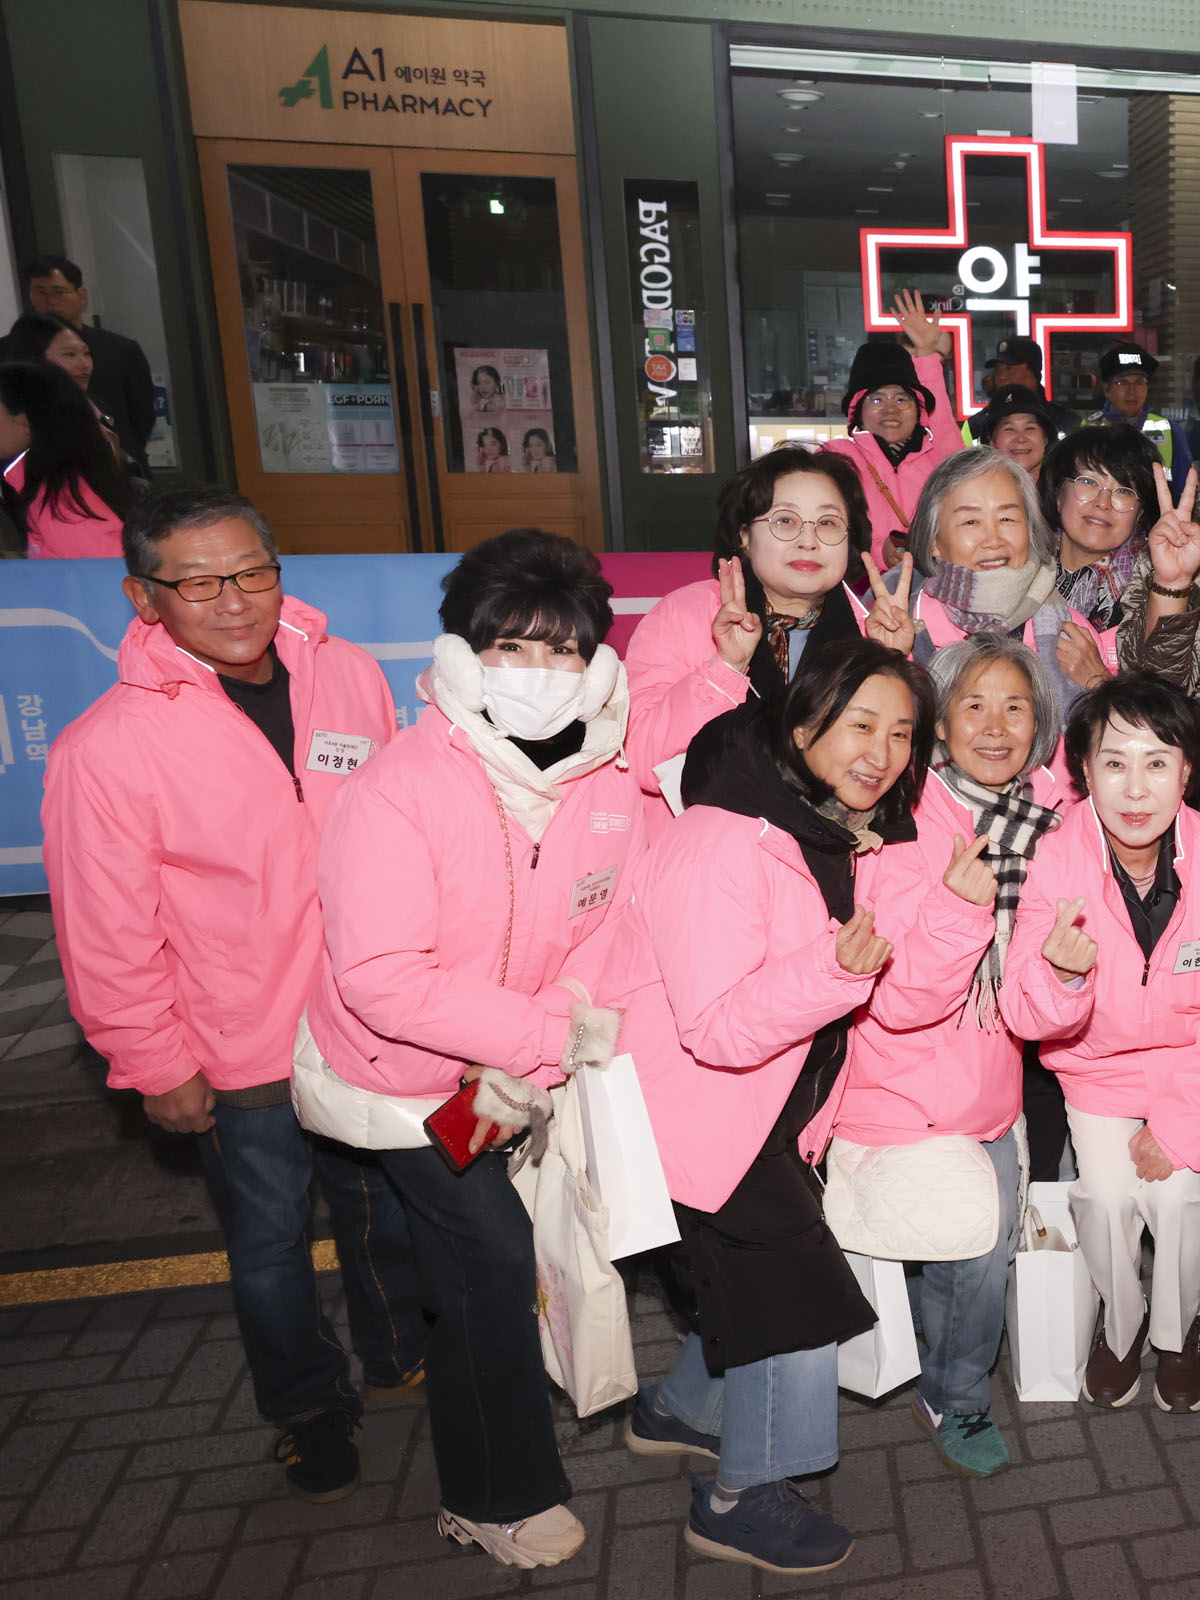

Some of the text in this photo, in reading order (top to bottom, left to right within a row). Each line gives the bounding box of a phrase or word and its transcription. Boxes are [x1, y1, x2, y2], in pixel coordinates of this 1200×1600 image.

[342, 46, 486, 87] A1 에이원 약국
[343, 91, 492, 117] PHARMACY
[958, 243, 1041, 336] 약
